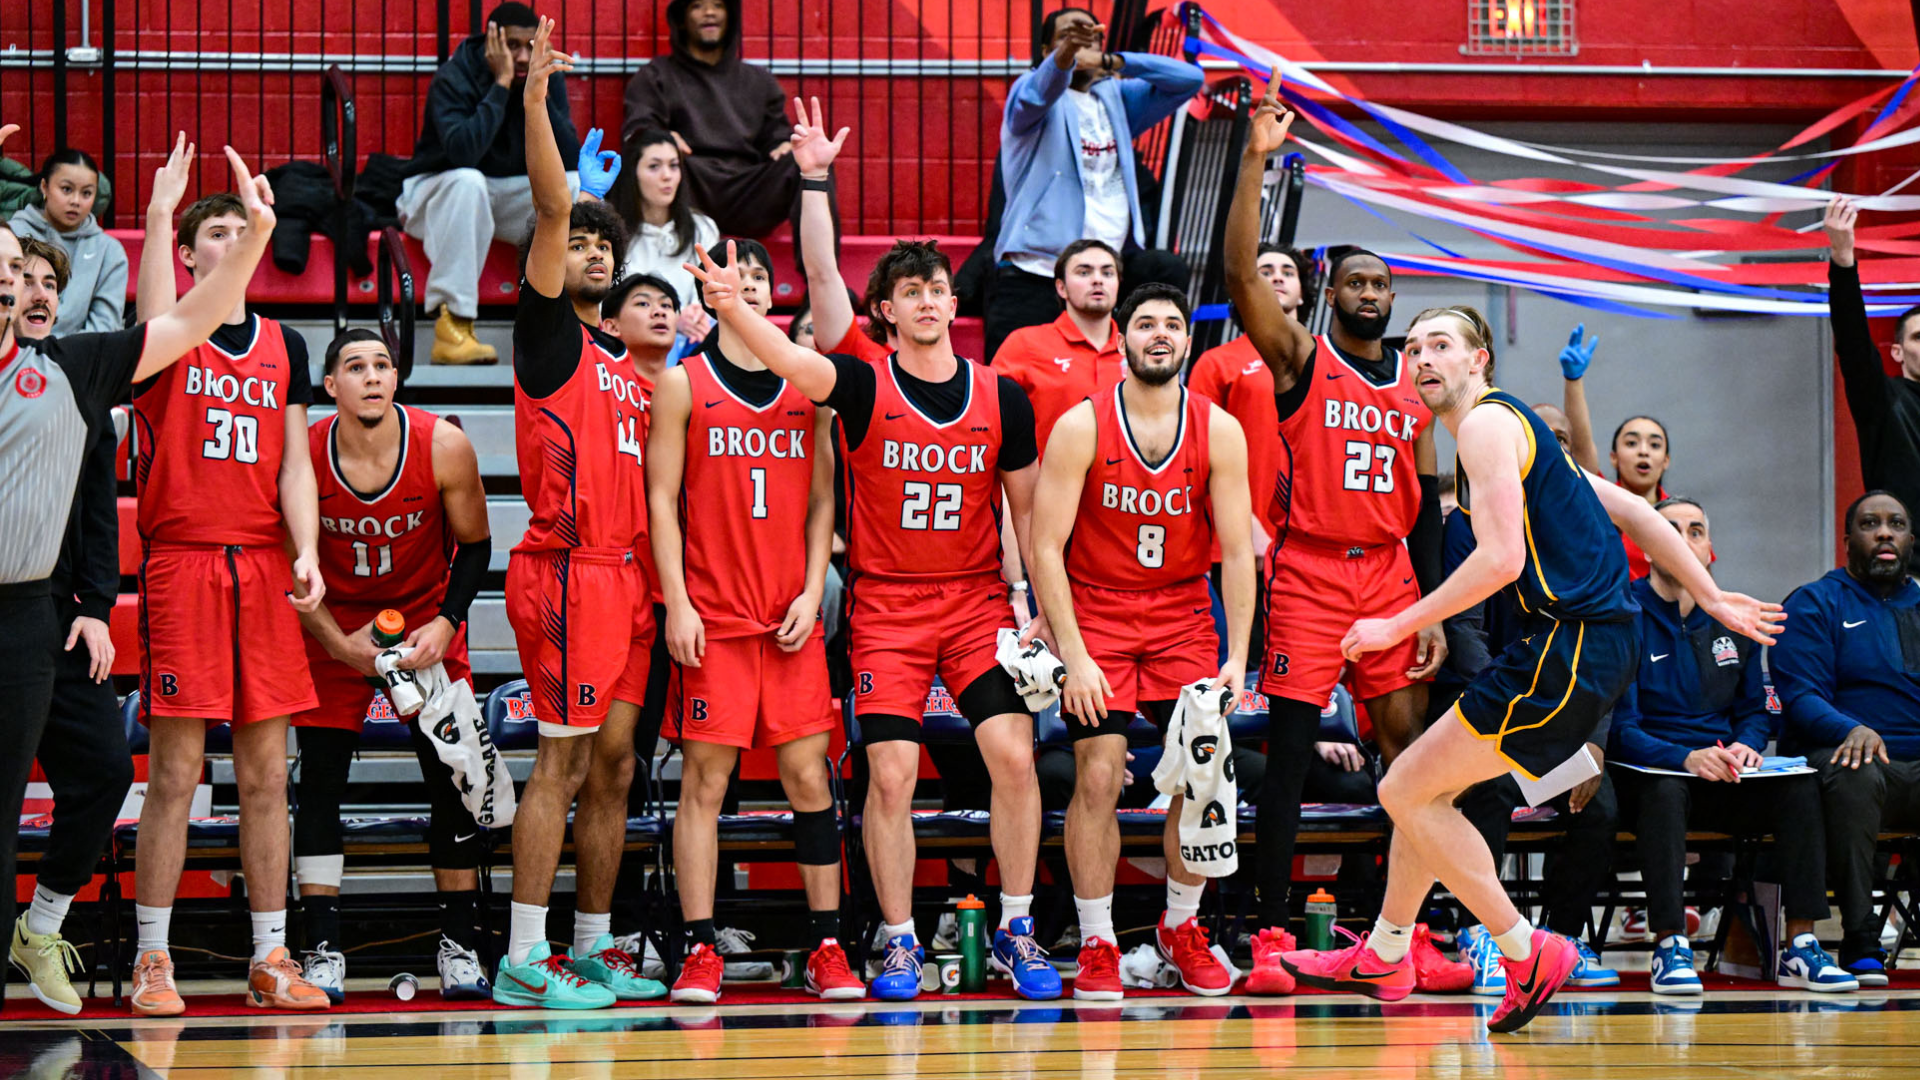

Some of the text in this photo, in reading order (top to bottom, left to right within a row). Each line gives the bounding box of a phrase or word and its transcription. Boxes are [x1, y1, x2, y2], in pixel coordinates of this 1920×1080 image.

[184, 364, 279, 411] BROCK
[202, 406, 259, 465] 30
[1323, 398, 1418, 442] BROCK
[708, 425, 806, 460] BROCK
[882, 438, 989, 475] BROCK
[1342, 439, 1397, 495] 23
[750, 467, 769, 520] 1
[900, 480, 964, 532] 22
[319, 508, 424, 539] BROCK
[351, 540, 393, 577] 11
[1136, 522, 1167, 569] 8
[1272, 651, 1291, 677] B
[157, 672, 180, 697] B
[575, 682, 598, 708] B
[857, 671, 875, 696] B
[690, 696, 709, 722] B
[1180, 838, 1238, 862] GATO
